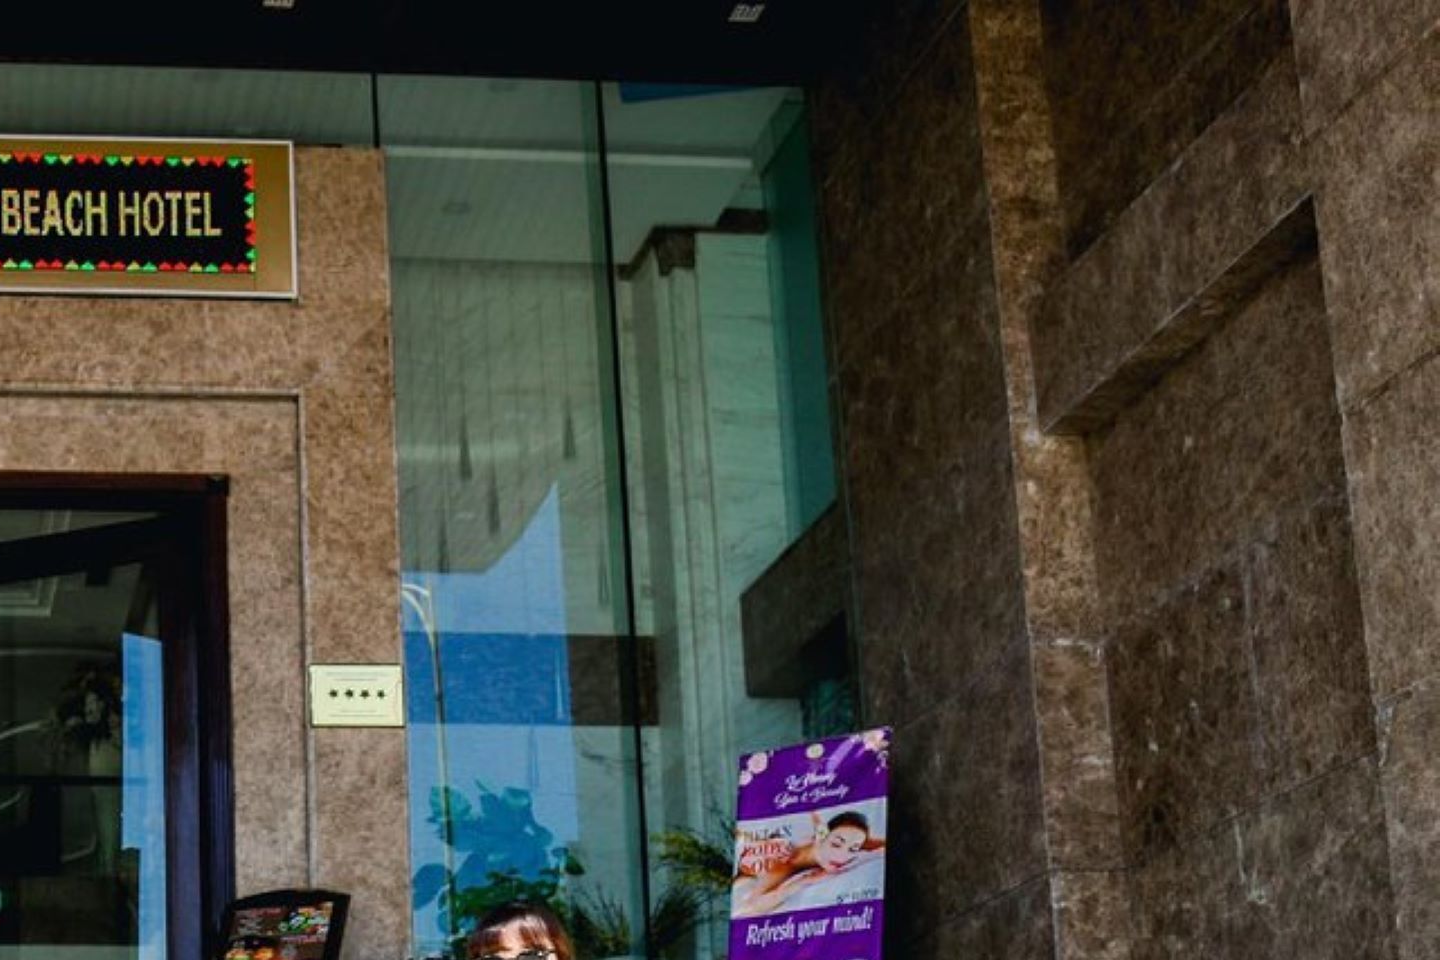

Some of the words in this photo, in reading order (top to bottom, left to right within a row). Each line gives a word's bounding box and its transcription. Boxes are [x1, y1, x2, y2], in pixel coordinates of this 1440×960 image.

[1, 189, 107, 236] BEACH
[118, 191, 221, 236] HOTEL
[746, 917, 794, 947] Refresh
[797, 919, 830, 944] your
[832, 906, 873, 932] mind!
